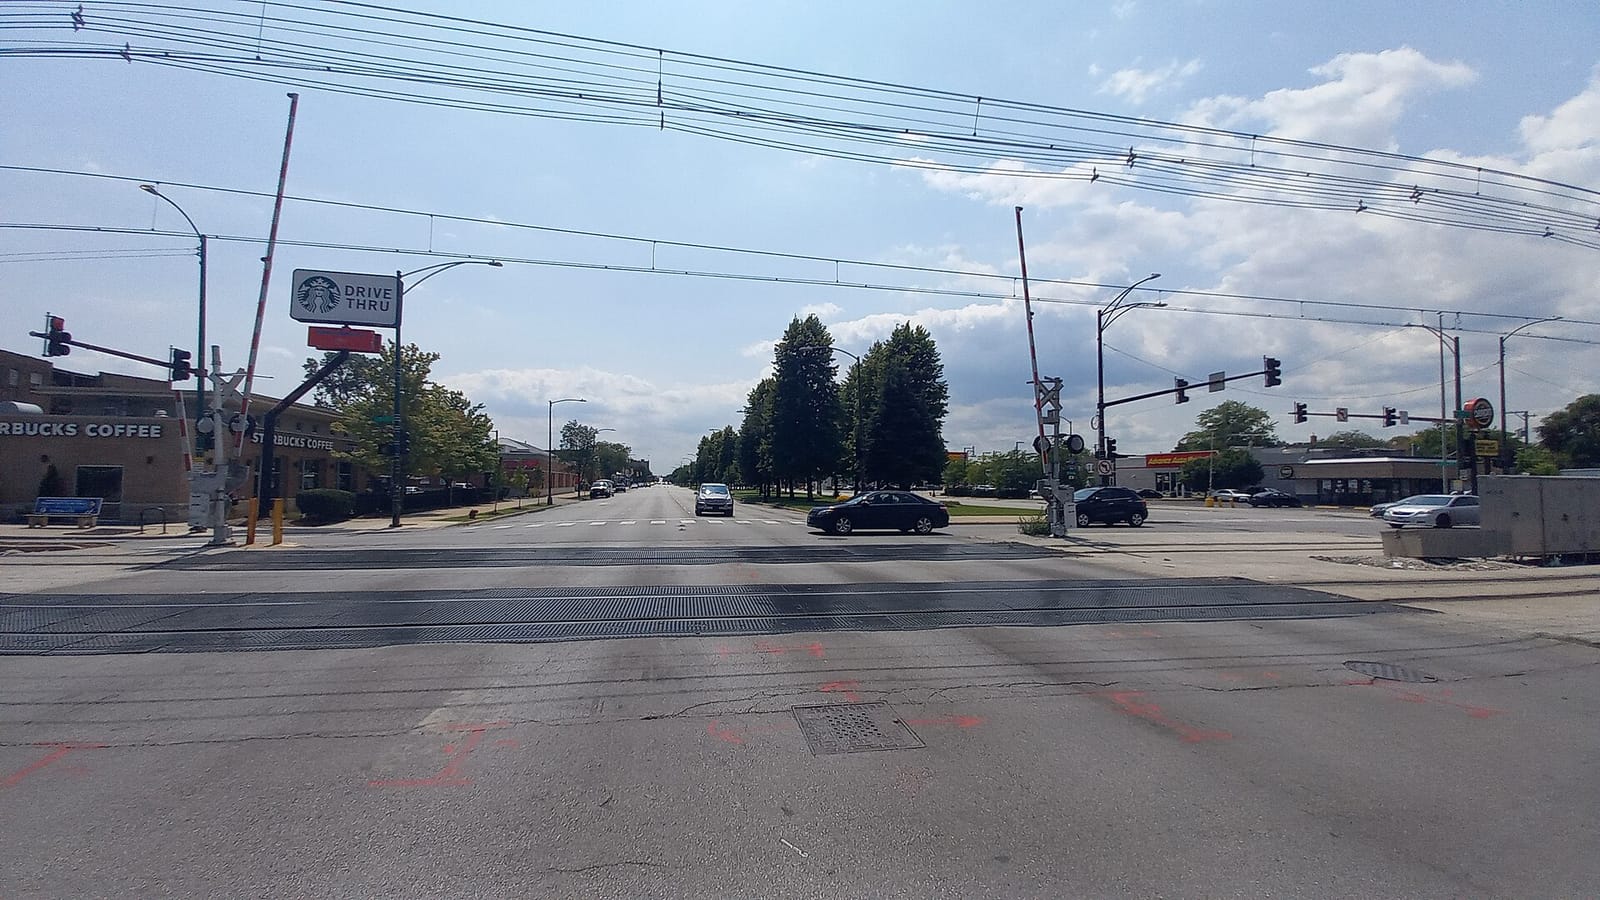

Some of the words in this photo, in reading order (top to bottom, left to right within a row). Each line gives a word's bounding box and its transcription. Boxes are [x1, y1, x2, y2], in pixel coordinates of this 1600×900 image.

[344, 285, 392, 300] DRIVE
[346, 298, 390, 312] THRU
[85, 423, 162, 438] COFFEE
[252, 432, 305, 448] STRBUCKS
[307, 438, 334, 450] COFFEE
